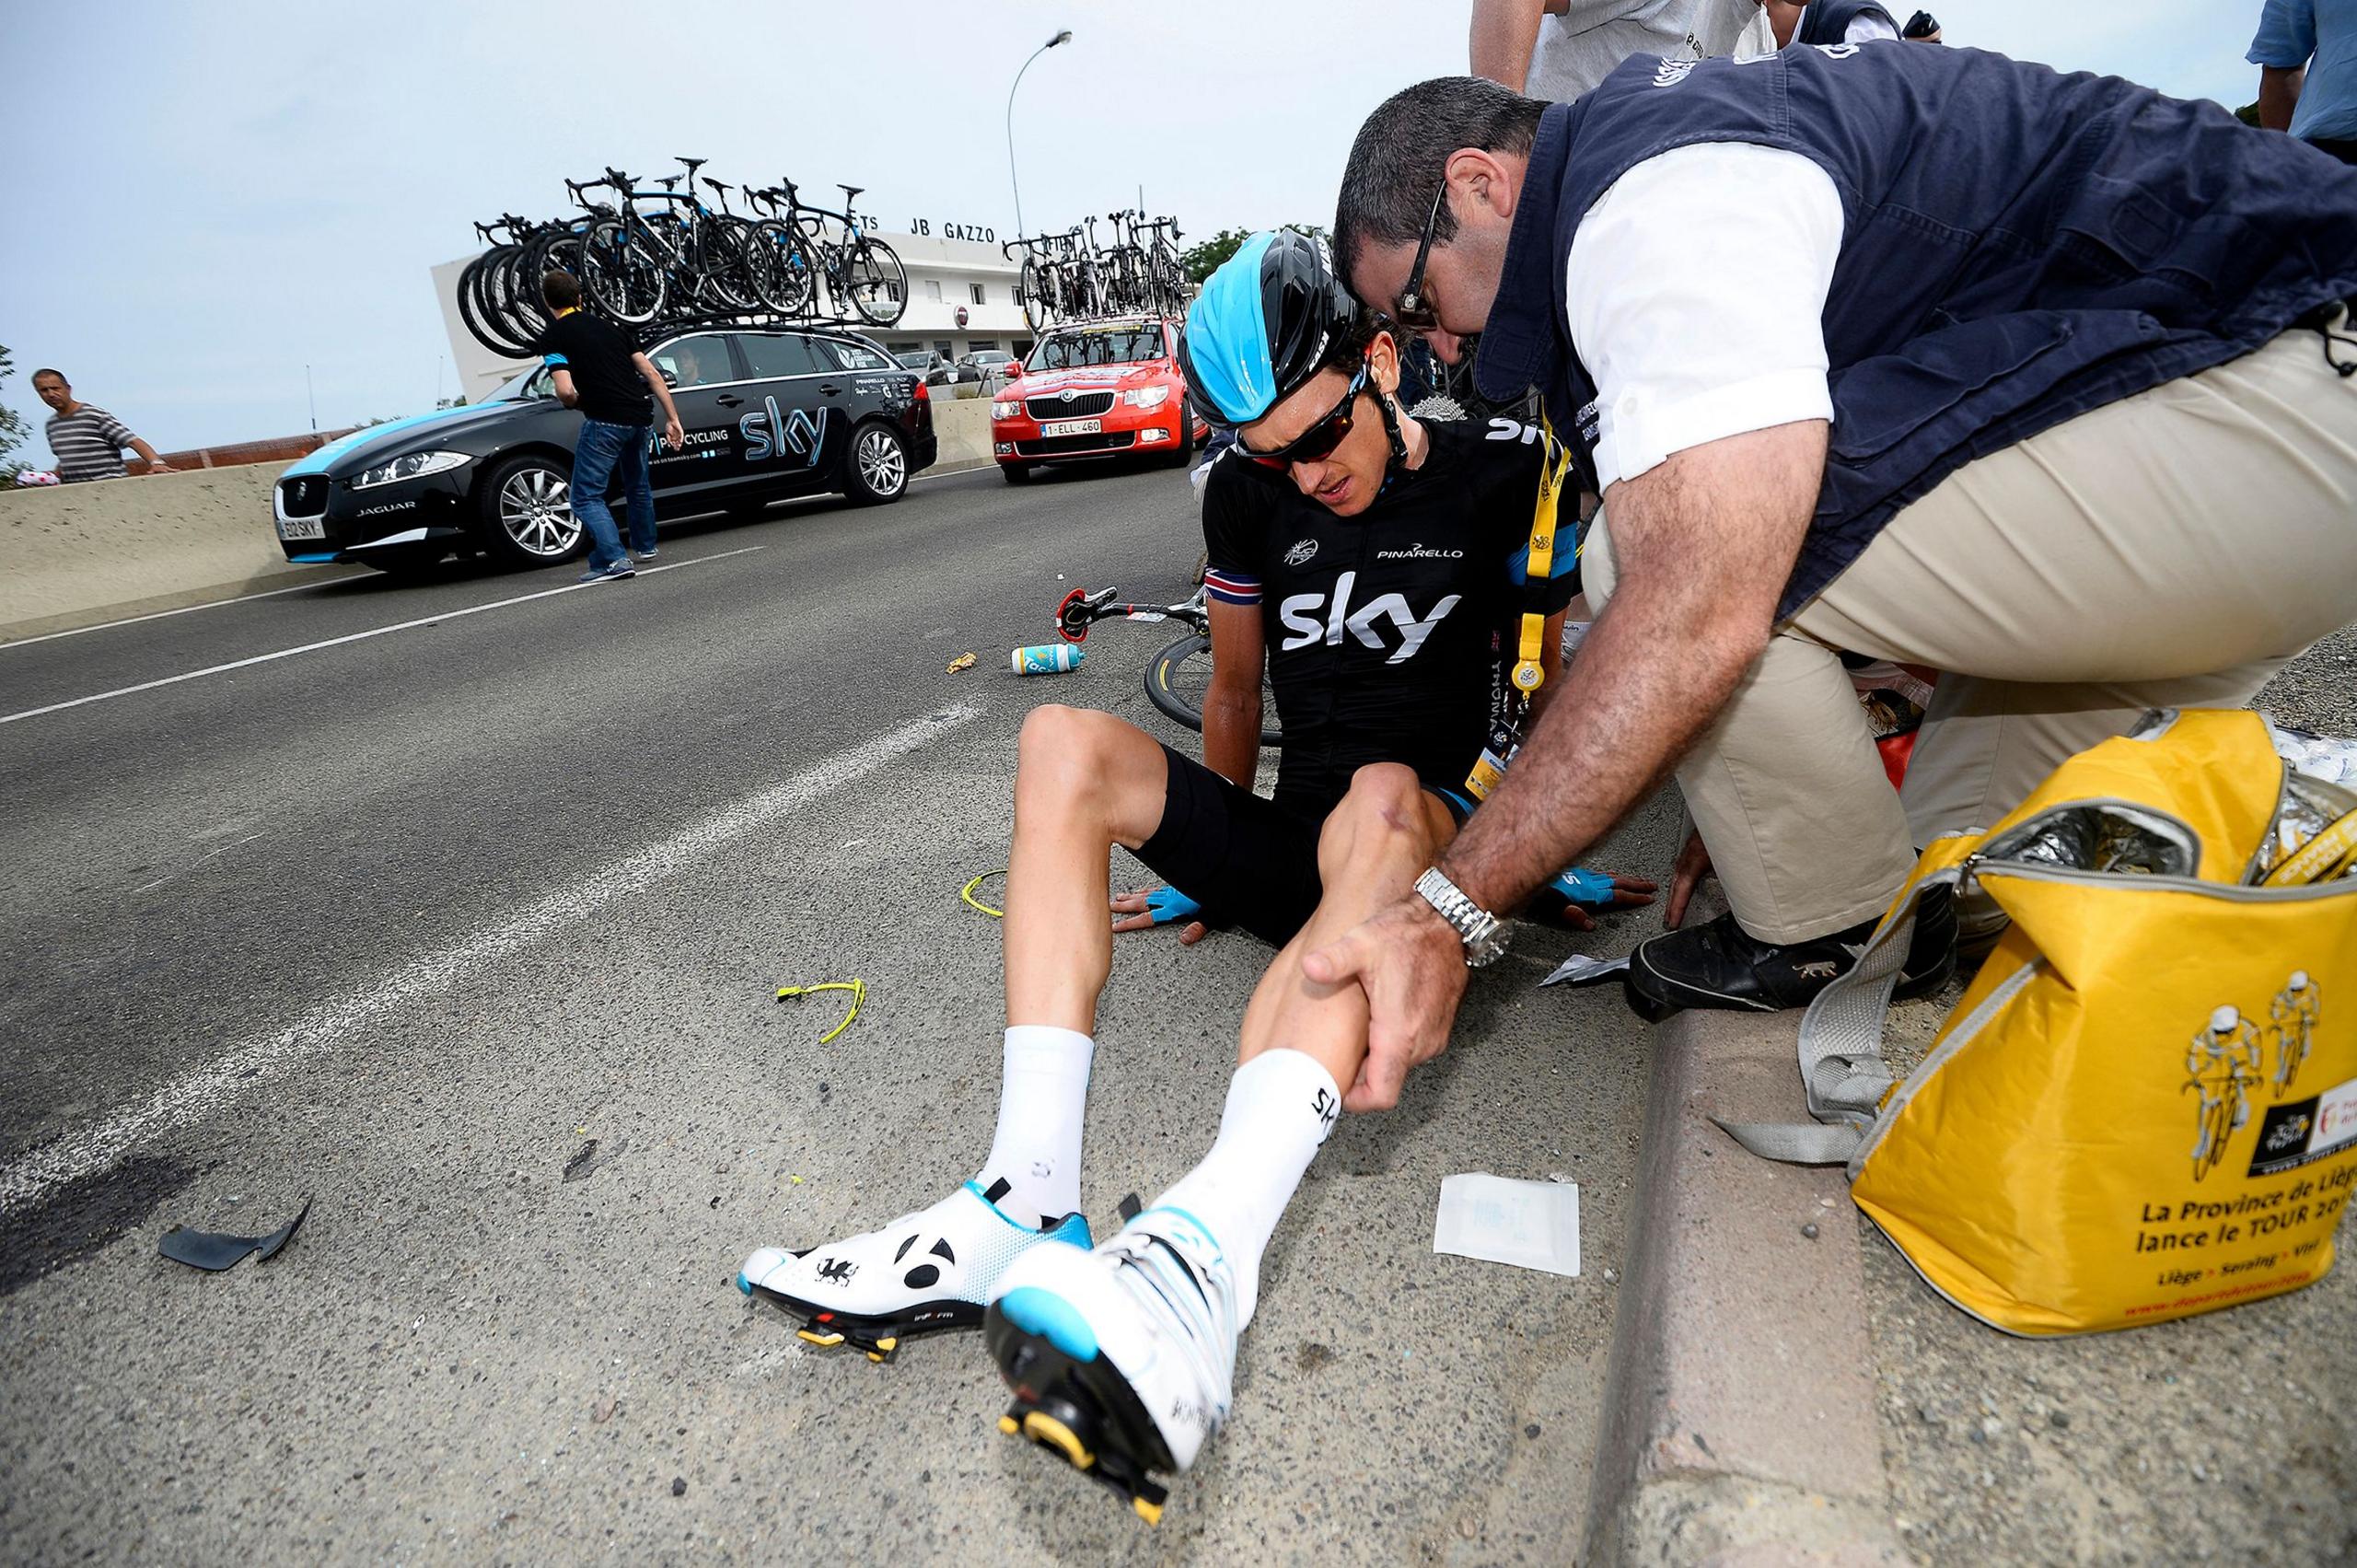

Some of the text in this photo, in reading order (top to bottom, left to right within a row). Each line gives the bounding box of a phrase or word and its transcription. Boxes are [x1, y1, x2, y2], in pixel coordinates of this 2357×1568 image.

[911, 218, 930, 236] JB
[945, 222, 994, 243] GAZZO
[684, 430, 728, 445] CYCLING
[356, 501, 416, 517] JAGUAR
[297, 520, 318, 537] SKY
[1377, 545, 1464, 560] PINARELLO
[1025, 656, 1056, 673] Tac
[2142, 1202, 2170, 1223] La
[2179, 1192, 2283, 1220] Province
[2288, 1179, 2314, 1202] de
[2135, 1230, 2210, 1253] lance
[2217, 1222, 2240, 1244] le
[2249, 1204, 2310, 1237] TOUR
